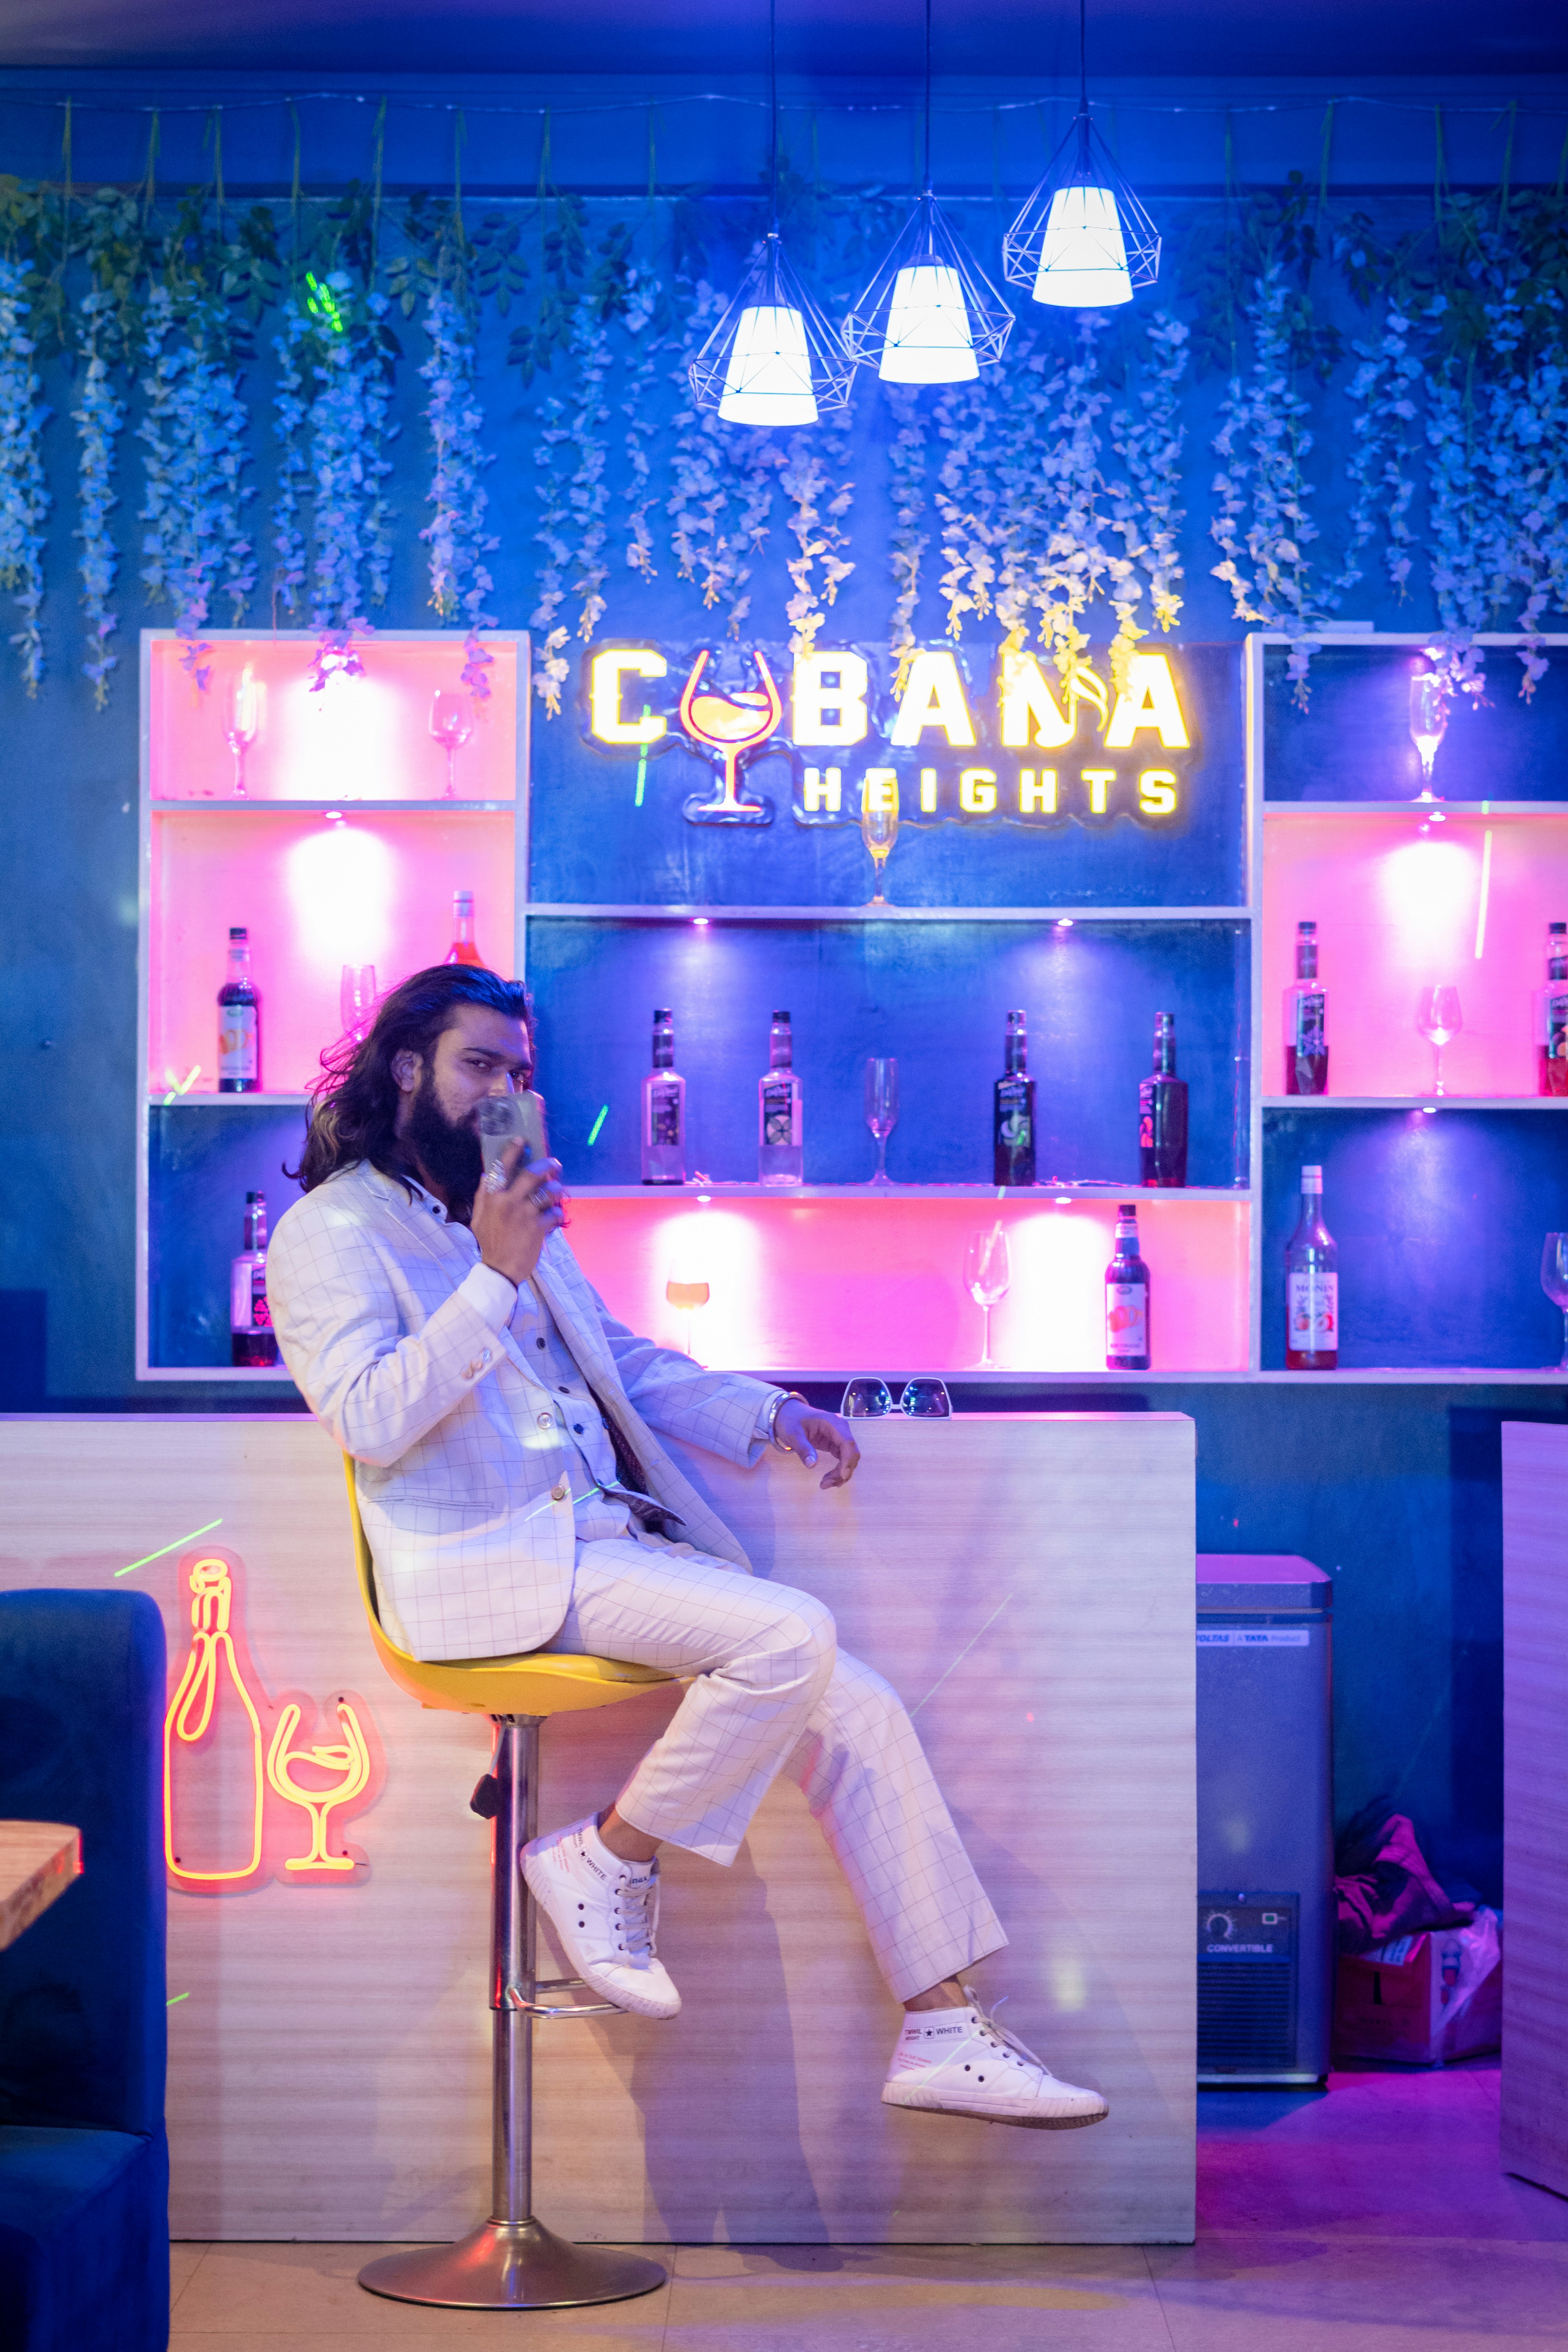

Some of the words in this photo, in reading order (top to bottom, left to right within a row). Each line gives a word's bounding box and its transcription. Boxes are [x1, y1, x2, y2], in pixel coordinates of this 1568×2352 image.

[803, 768, 1177, 815] HEIGHTS
[587, 1857, 607, 1880] WHITE
[1207, 1944, 1273, 1953] CONVERTIBLE
